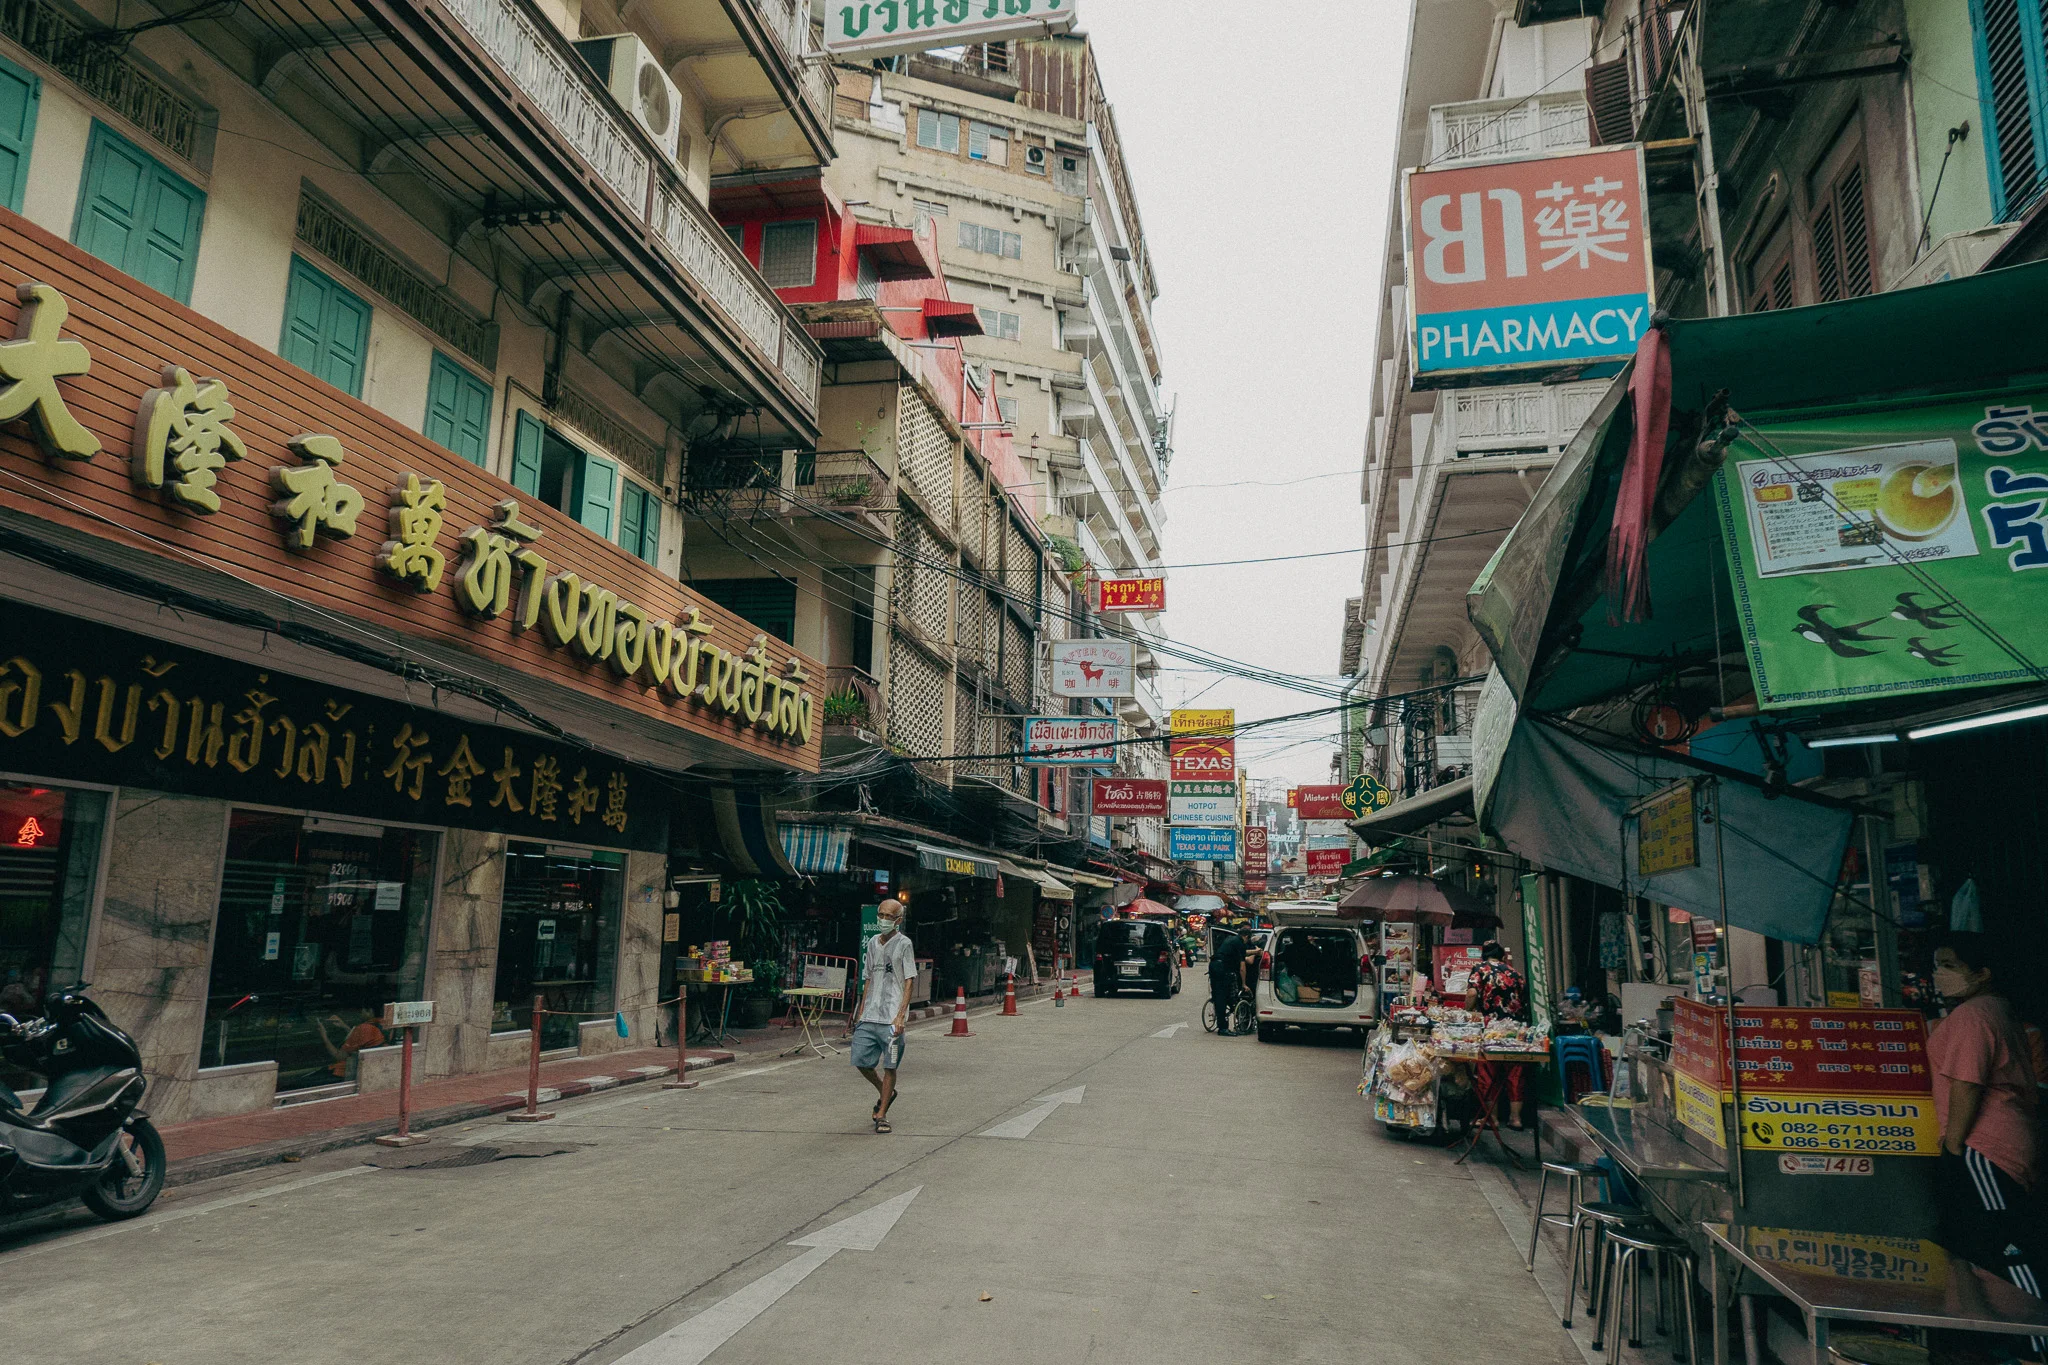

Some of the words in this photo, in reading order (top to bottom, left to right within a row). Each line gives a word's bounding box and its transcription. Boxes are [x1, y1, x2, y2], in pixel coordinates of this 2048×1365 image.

[1421, 306, 1643, 361] PHARMACY
[1062, 647, 1098, 665] AFTER
[1101, 648, 1126, 665] YOU
[1173, 757, 1233, 770] TEXAS
[1303, 793, 1330, 803] Mister
[1187, 802, 1218, 810] HOTPOT
[1205, 814, 1234, 822] CUISINE
[1176, 843, 1196, 851] TEXAS
[1197, 843, 1211, 851] CAR
[1213, 843, 1230, 852] PARK
[1873, 1020, 1903, 1031] 200
[1877, 1041, 1907, 1052] 150
[1880, 1063, 1910, 1074] 100
[1747, 1096, 1919, 1119] รังนกสิริรามา
[1781, 1121, 1915, 1139] 082-6711888
[1782, 1135, 1917, 1152] 086-6120238
[1824, 1157, 1872, 1174] 1418
